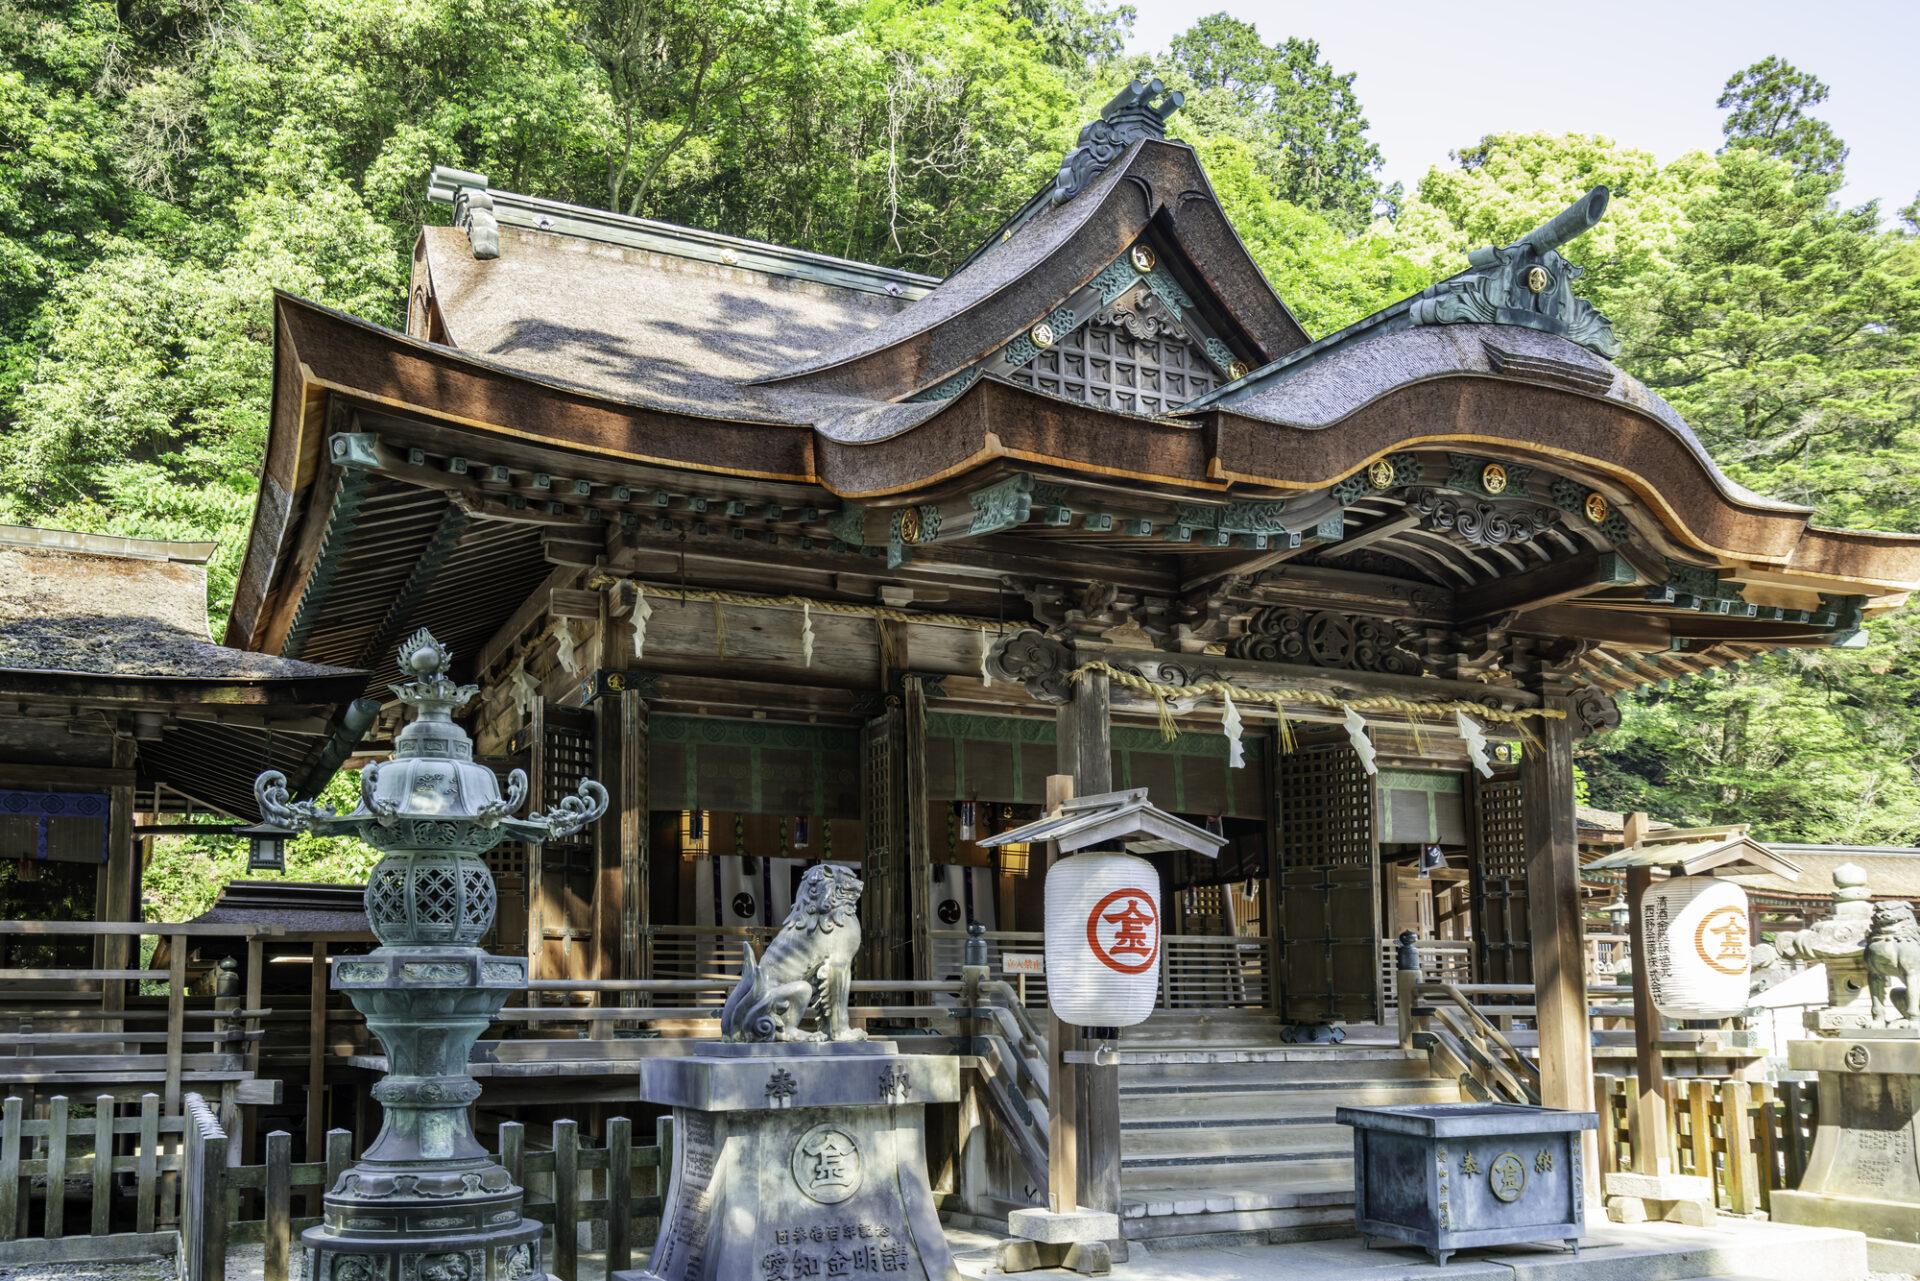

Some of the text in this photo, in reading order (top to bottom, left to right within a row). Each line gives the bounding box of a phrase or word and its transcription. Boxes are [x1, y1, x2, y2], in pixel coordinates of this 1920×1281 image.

[1102, 900, 1155, 957] 金
[1709, 916, 1747, 960] 金
[1008, 958, 1041, 970] 立入禁止
[764, 1064, 911, 1100] 奉 納
[803, 1134, 856, 1188] 金
[1459, 1149, 1553, 1179] 奉 納
[1495, 1159, 1523, 1193] 金
